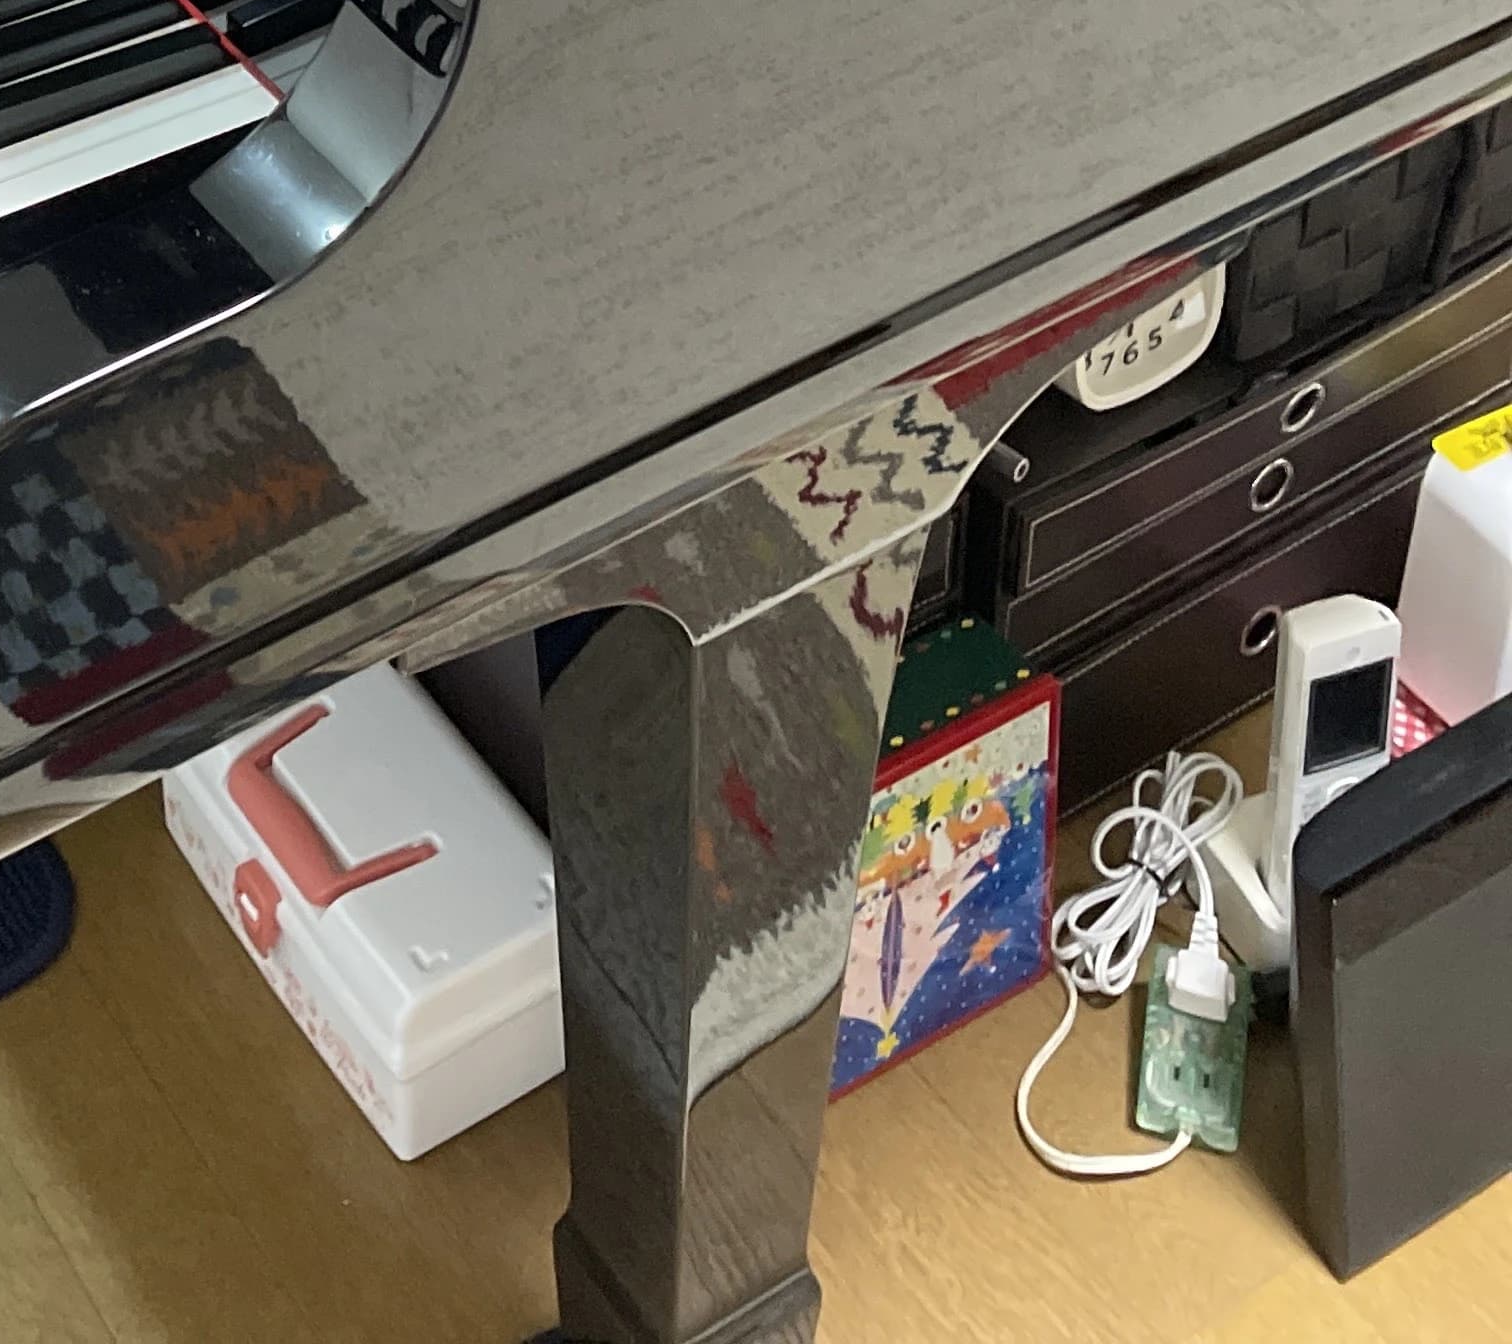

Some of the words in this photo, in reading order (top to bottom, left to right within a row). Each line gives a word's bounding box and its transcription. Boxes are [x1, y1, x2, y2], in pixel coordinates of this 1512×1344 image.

[1101, 350, 1115, 376] 7
[1123, 340, 1139, 365] 6
[1148, 325, 1162, 350] 5
